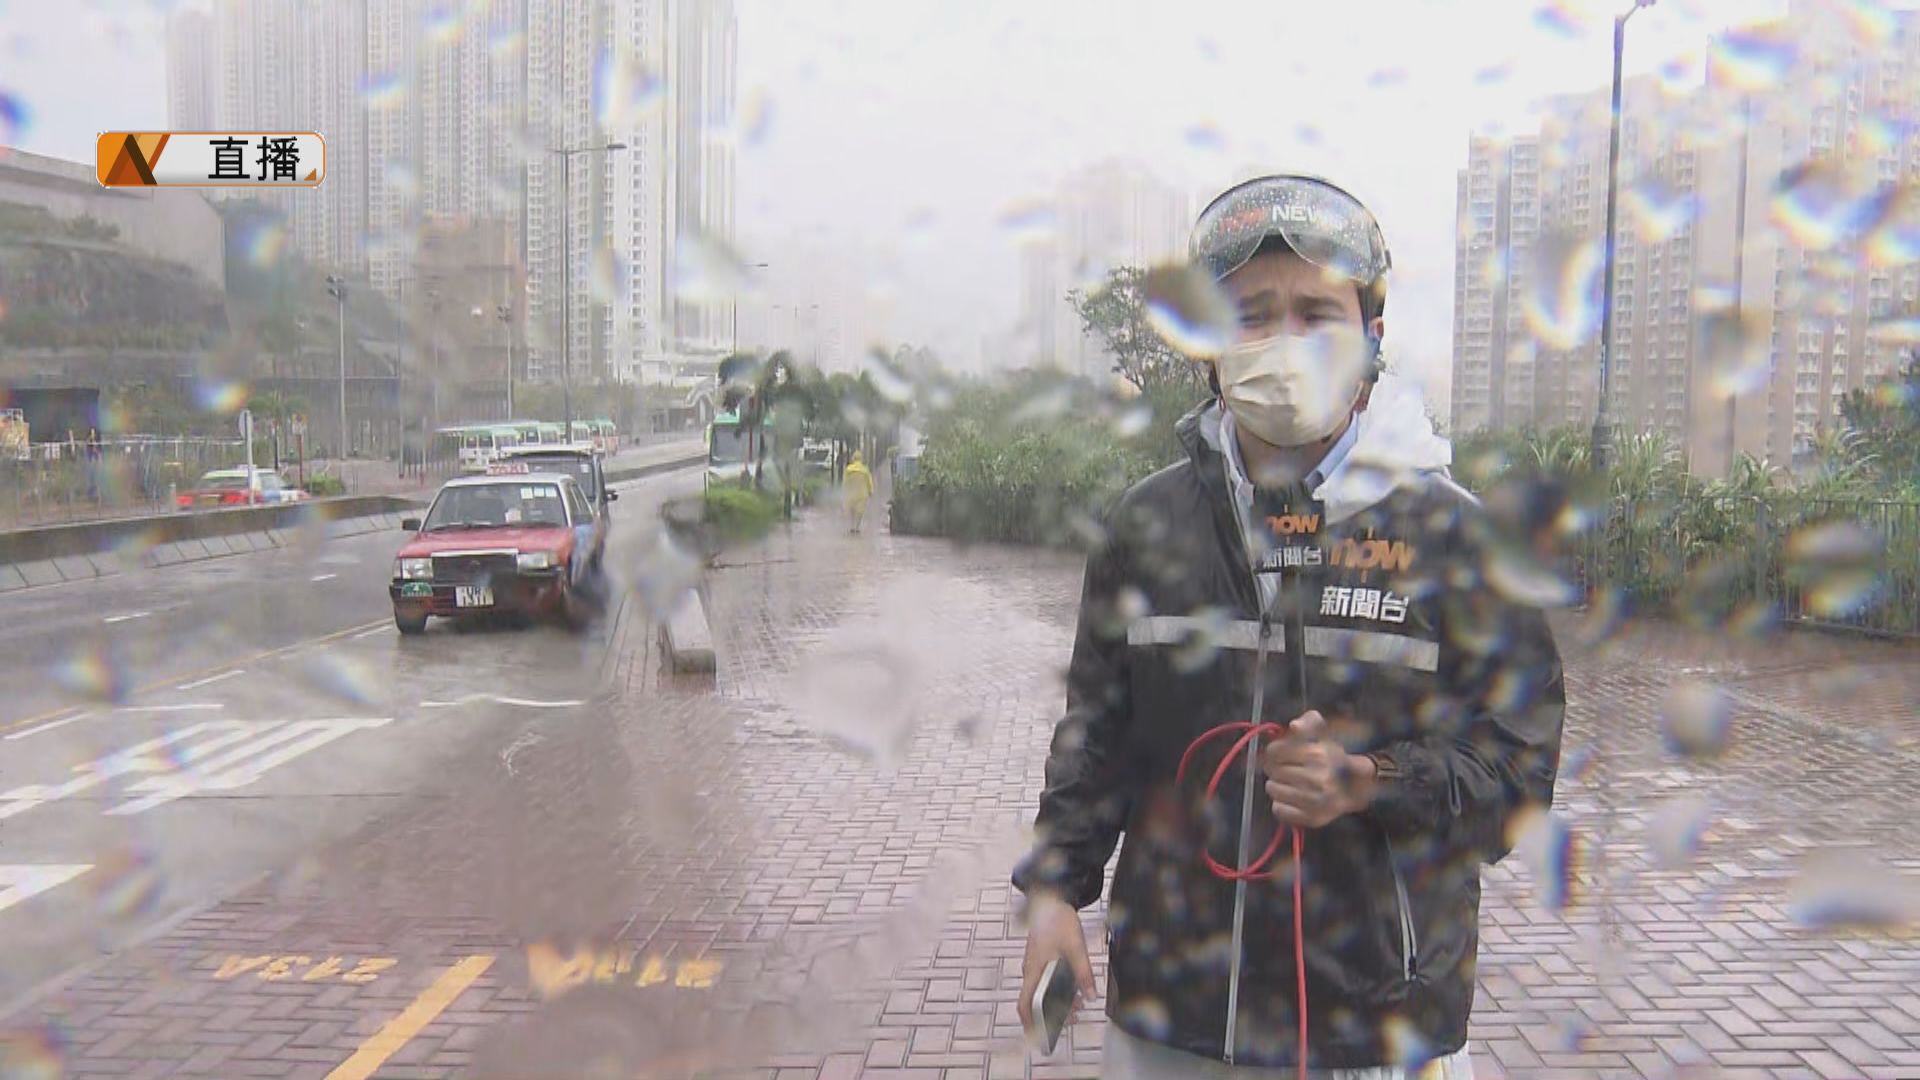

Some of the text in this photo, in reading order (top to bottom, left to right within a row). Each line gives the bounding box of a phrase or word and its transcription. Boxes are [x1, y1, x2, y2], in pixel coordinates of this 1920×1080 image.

[1330, 536, 1416, 572] now
[1320, 585, 1410, 624] 新聞台
